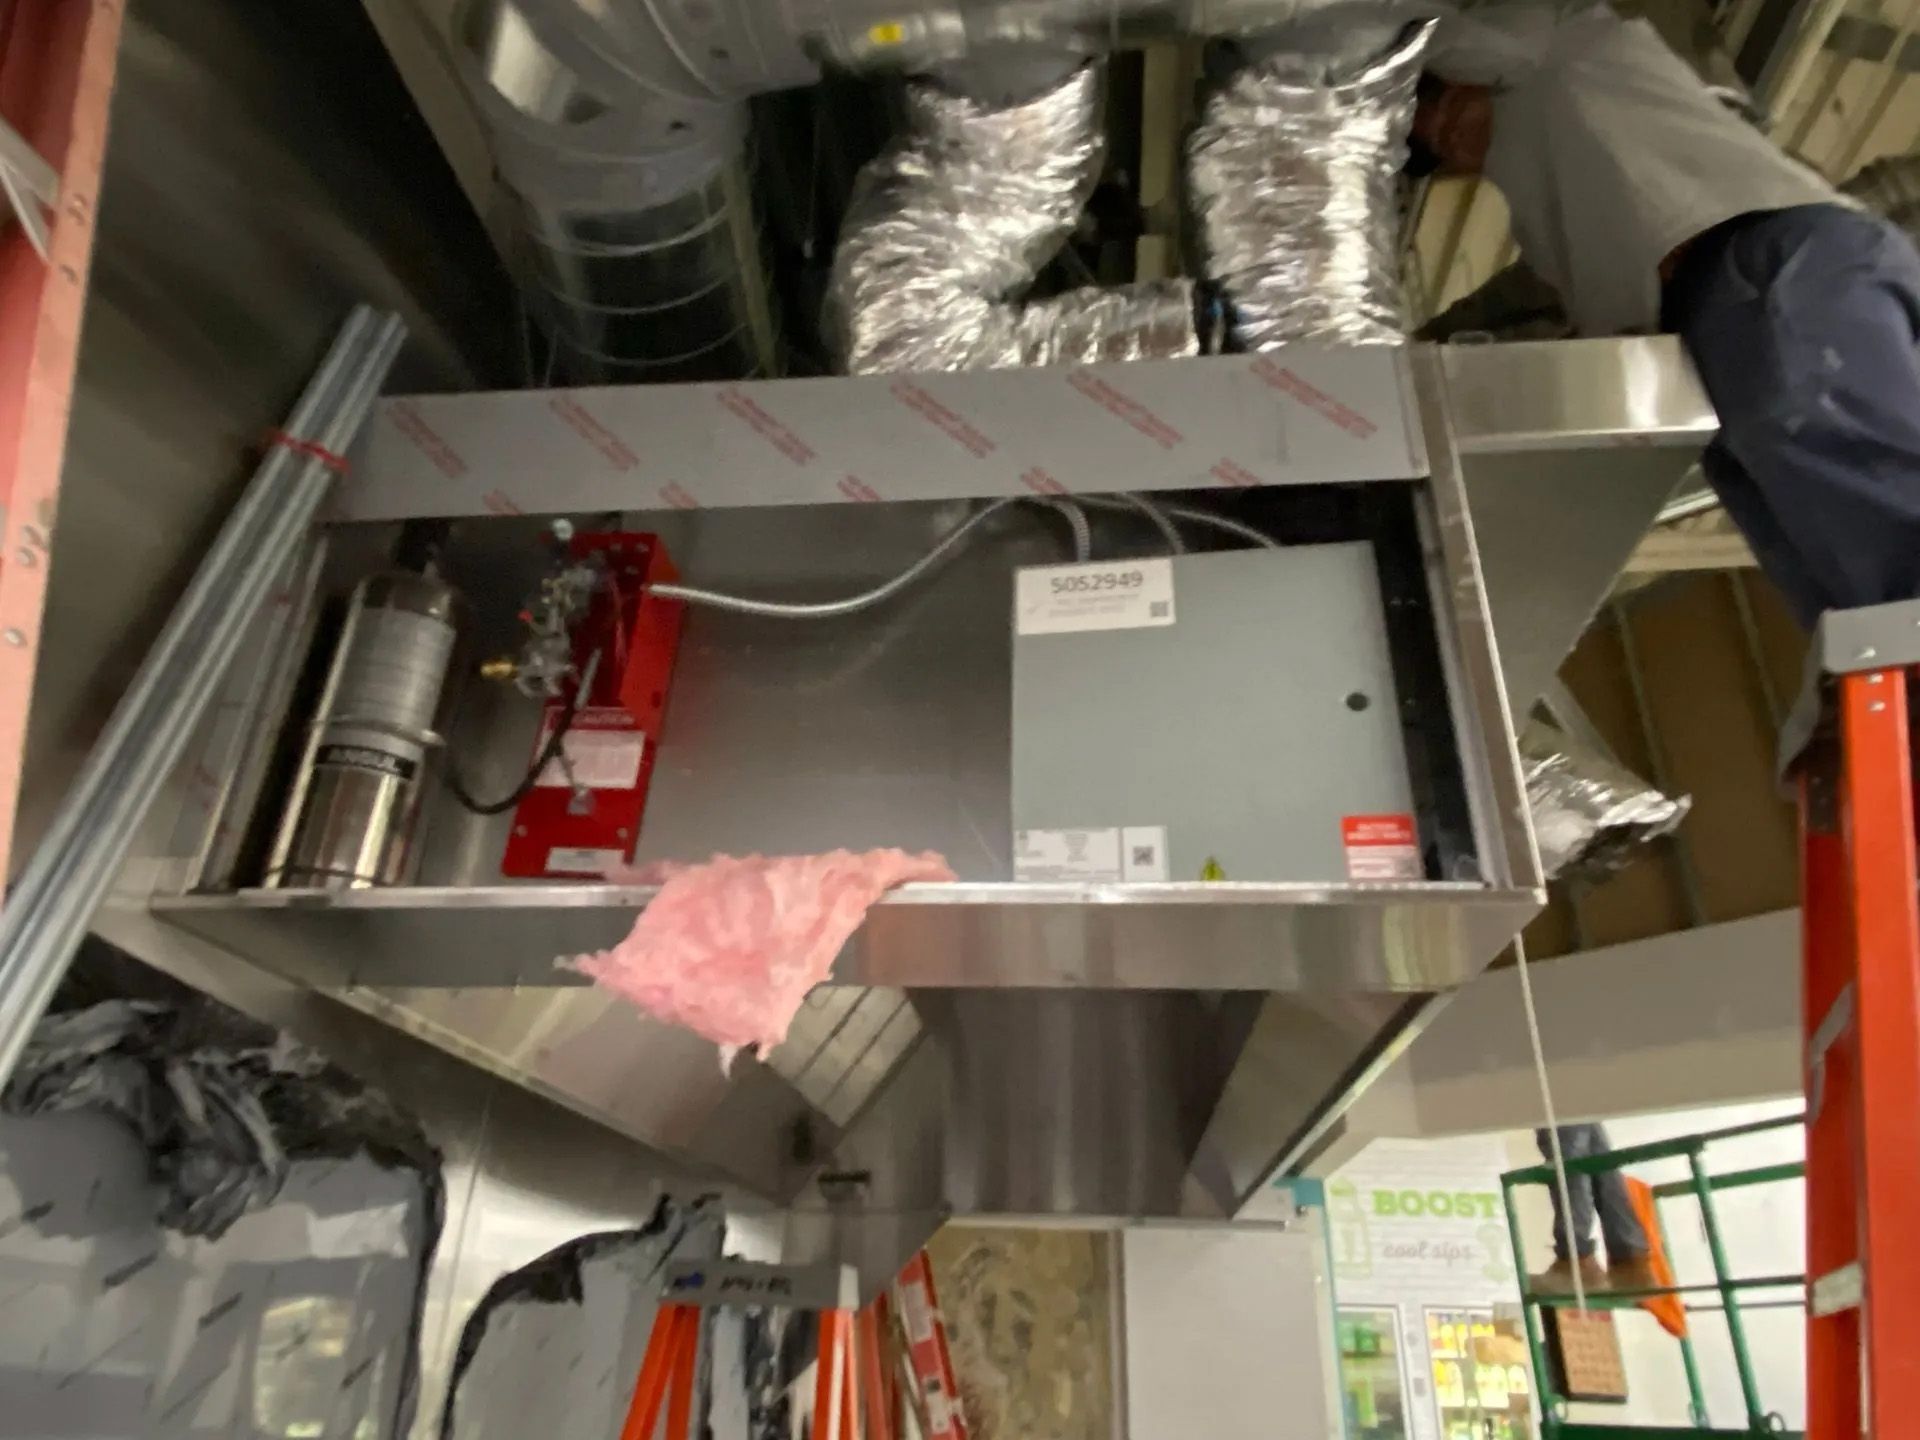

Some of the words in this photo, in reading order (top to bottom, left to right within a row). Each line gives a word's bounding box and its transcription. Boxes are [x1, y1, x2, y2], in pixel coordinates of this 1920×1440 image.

[1372, 1190, 1497, 1217] BOOST
[1383, 1241, 1428, 1258] cool
[1432, 1241, 1478, 1266] sips
